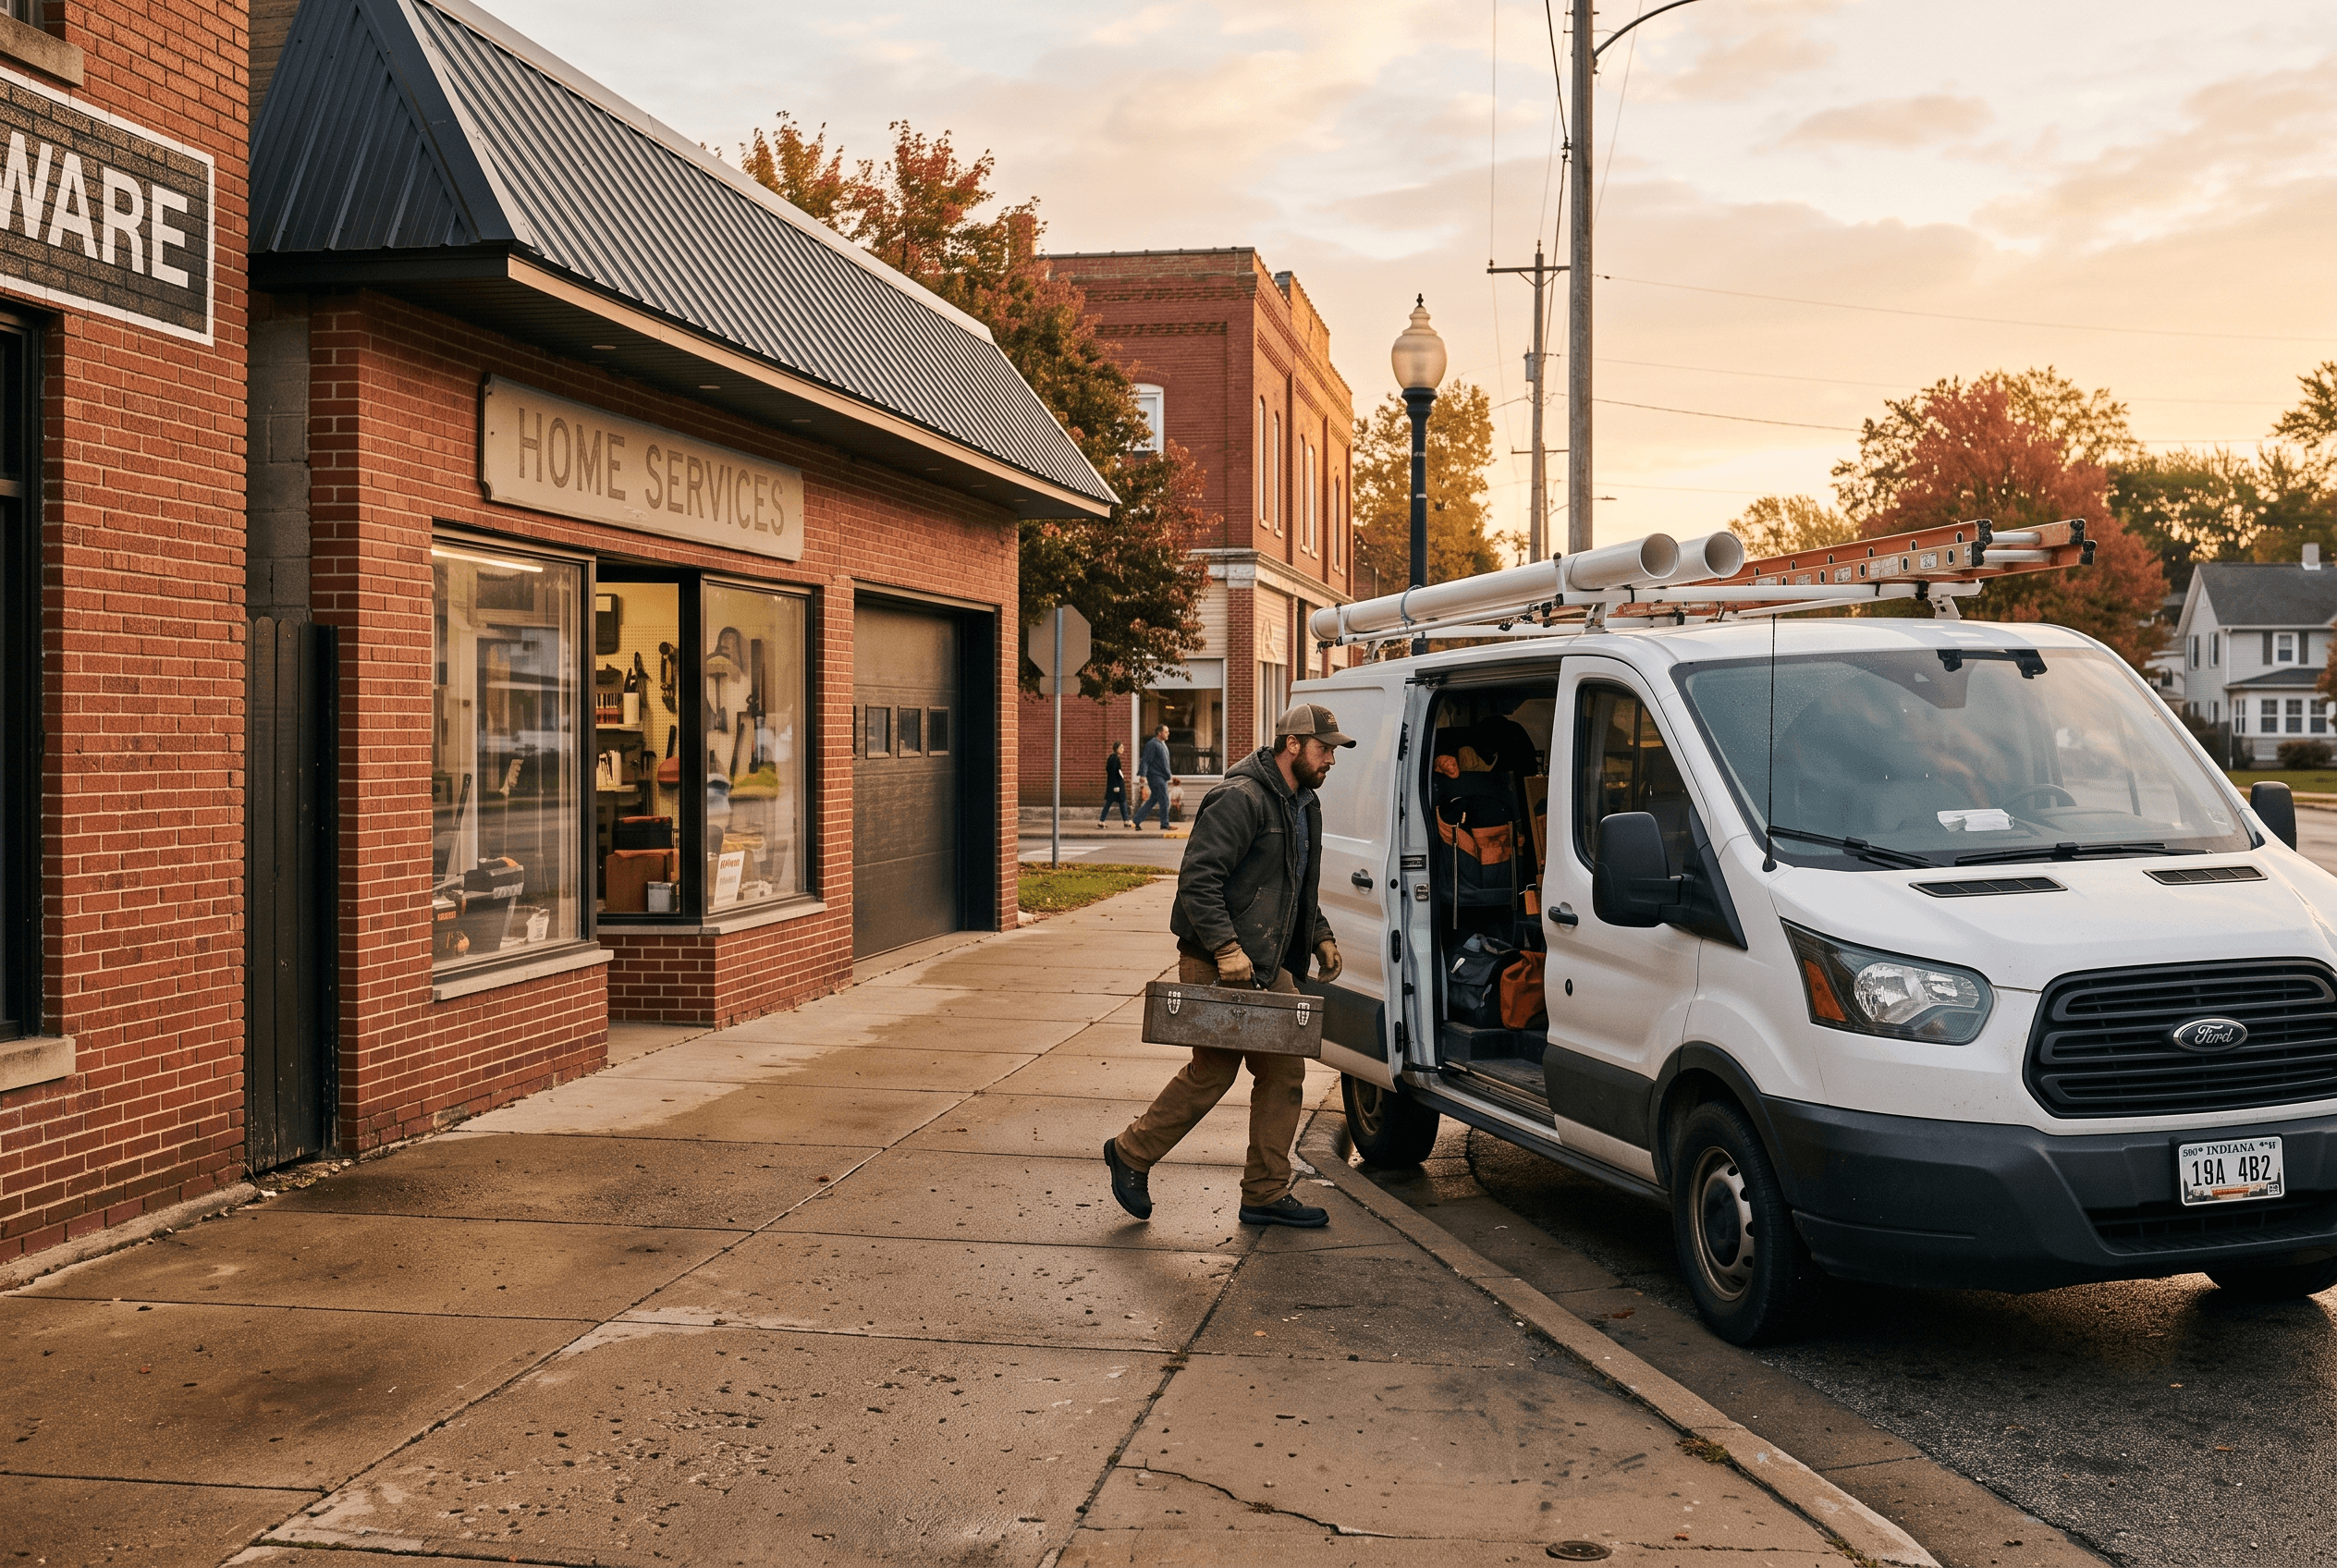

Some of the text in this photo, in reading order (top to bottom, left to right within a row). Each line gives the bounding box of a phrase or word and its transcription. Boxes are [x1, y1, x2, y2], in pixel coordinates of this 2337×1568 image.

[0, 130, 189, 289] WARE
[519, 407, 785, 536] HOME SERVICES
[2192, 1155, 2272, 1187] 19A 4B2
[2206, 1143, 2256, 1156] INDIANA
